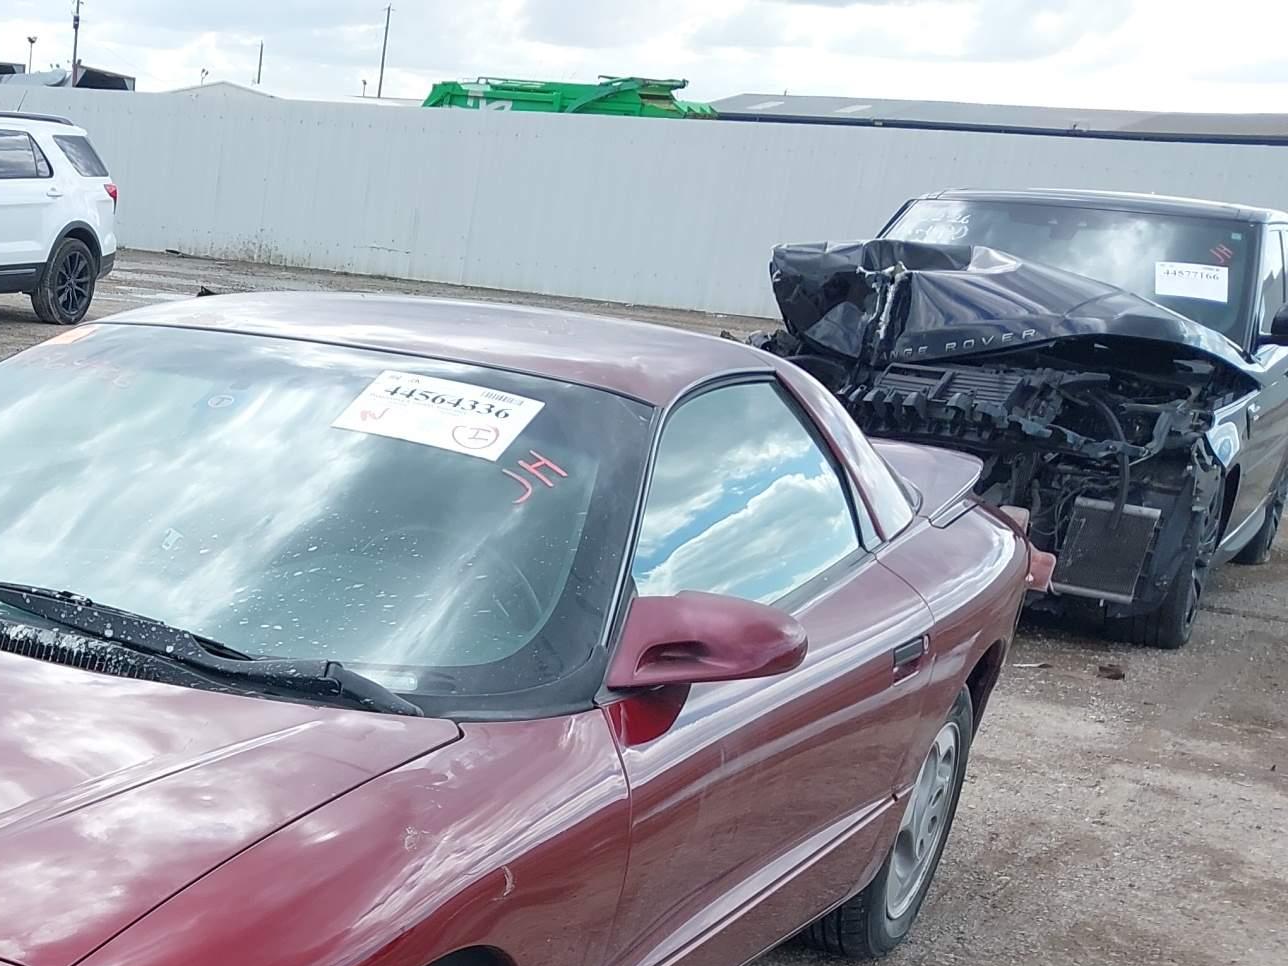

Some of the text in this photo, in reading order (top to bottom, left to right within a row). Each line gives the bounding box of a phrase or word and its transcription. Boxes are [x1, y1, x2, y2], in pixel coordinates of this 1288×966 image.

[1163, 269, 1220, 280] 44577166
[945, 329, 1036, 352] ROVER
[383, 385, 511, 419] 44564336
[502, 449, 569, 504] JH
